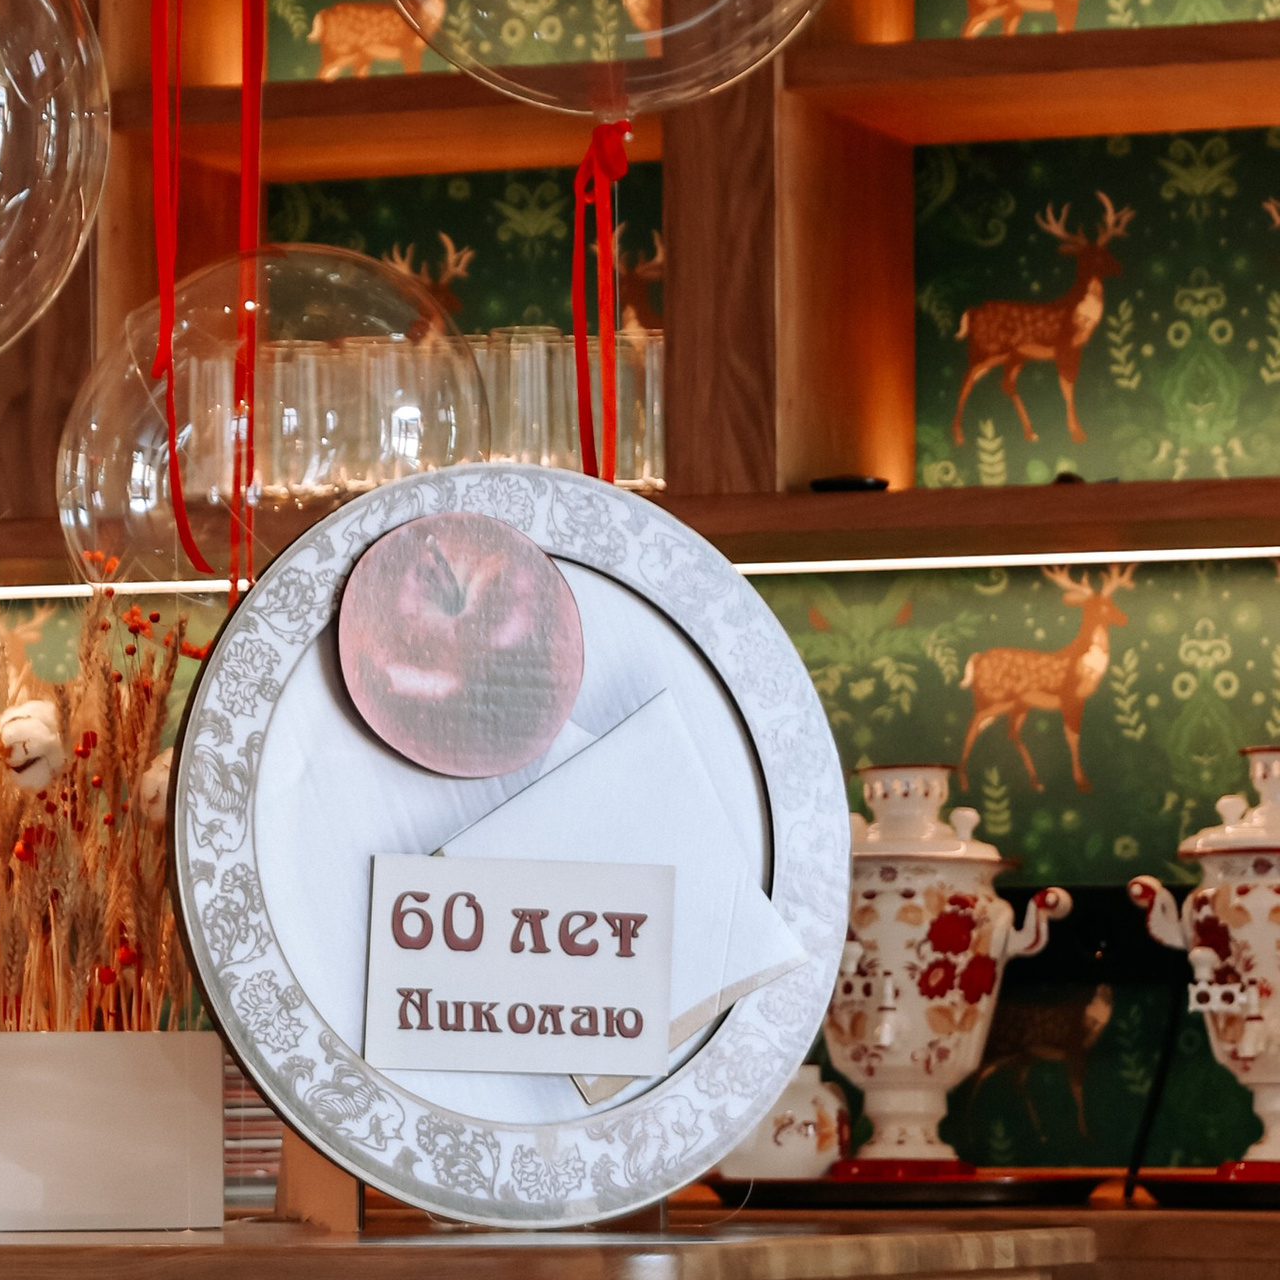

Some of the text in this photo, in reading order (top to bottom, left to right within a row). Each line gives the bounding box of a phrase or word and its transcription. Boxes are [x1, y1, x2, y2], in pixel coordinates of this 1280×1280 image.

[391, 890, 649, 958] 60 лет
[396, 987, 644, 1039] Николаю
